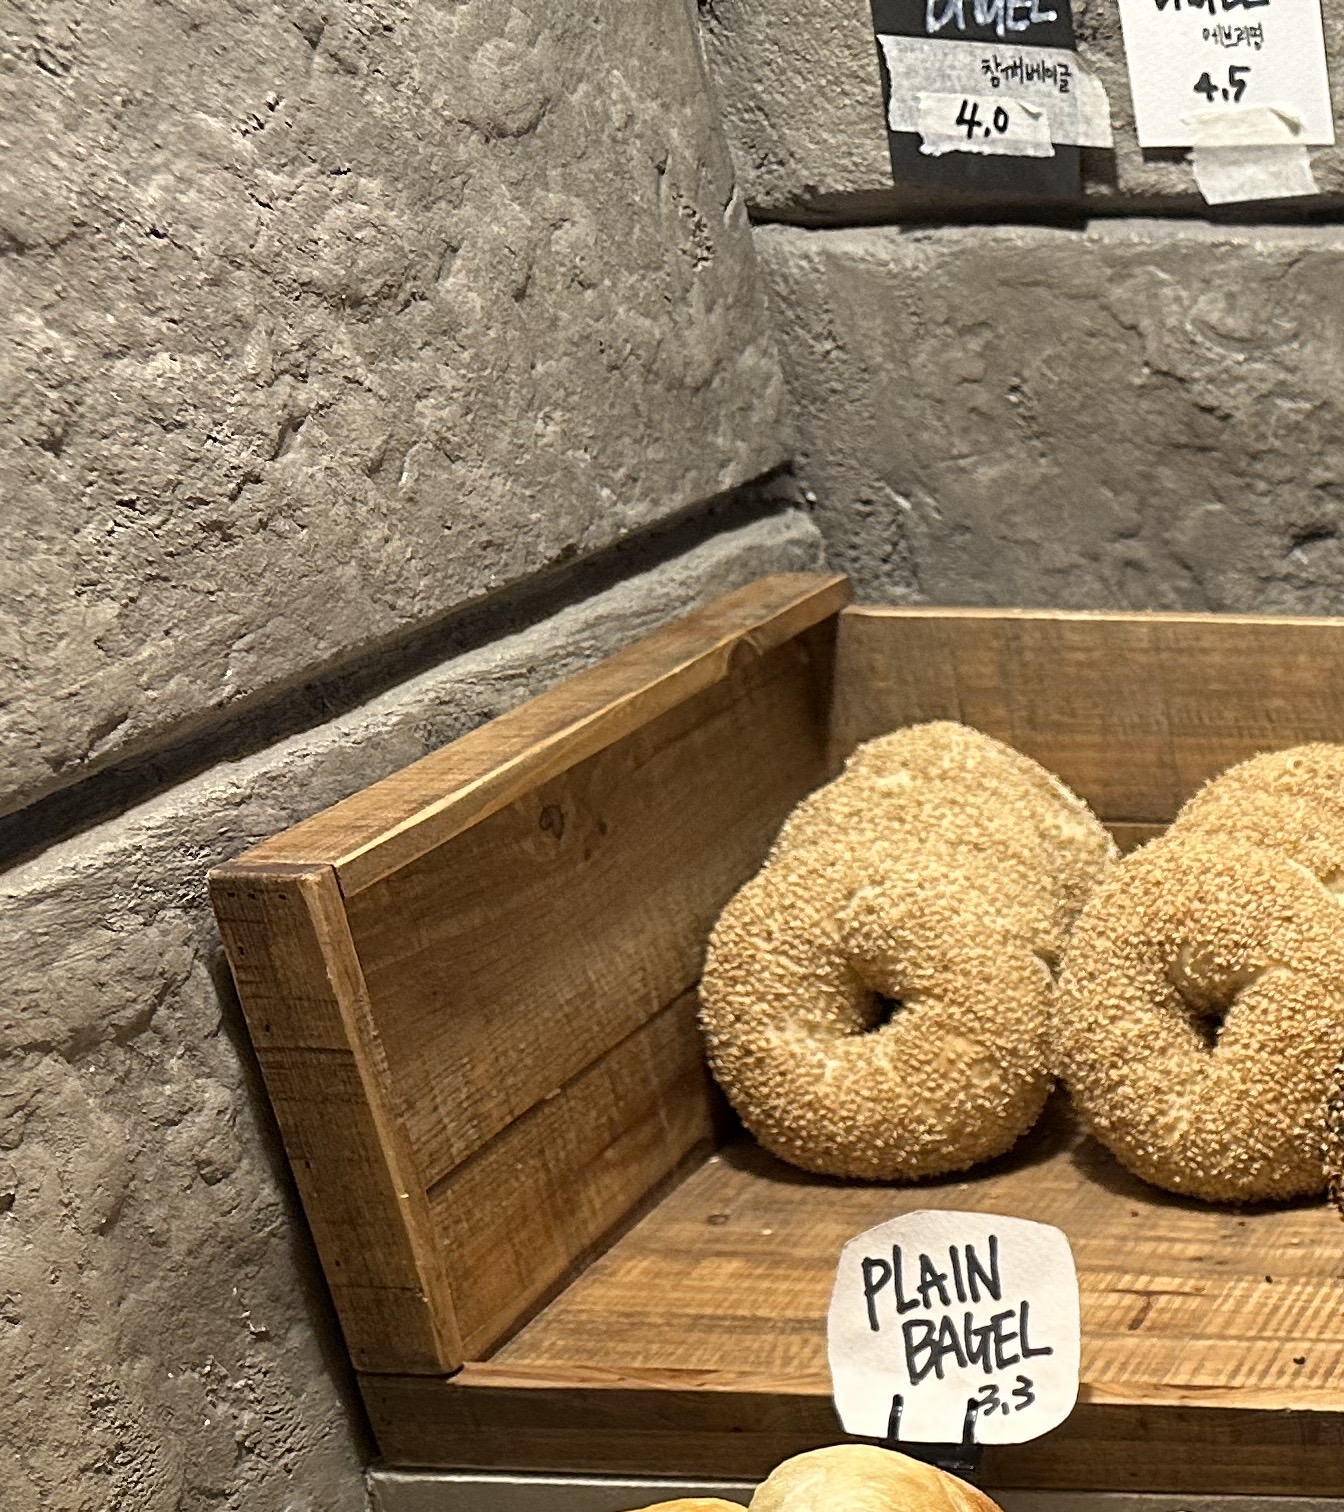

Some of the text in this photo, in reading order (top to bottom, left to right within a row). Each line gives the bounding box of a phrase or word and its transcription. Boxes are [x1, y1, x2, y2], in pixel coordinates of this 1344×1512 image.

[1194, 65, 1251, 102] 4.5
[956, 99, 1009, 139] 4.0
[862, 1235, 1002, 1331] PLAIN
[902, 1300, 1054, 1386] BAGEL
[978, 1375, 1035, 1416] 3.3
